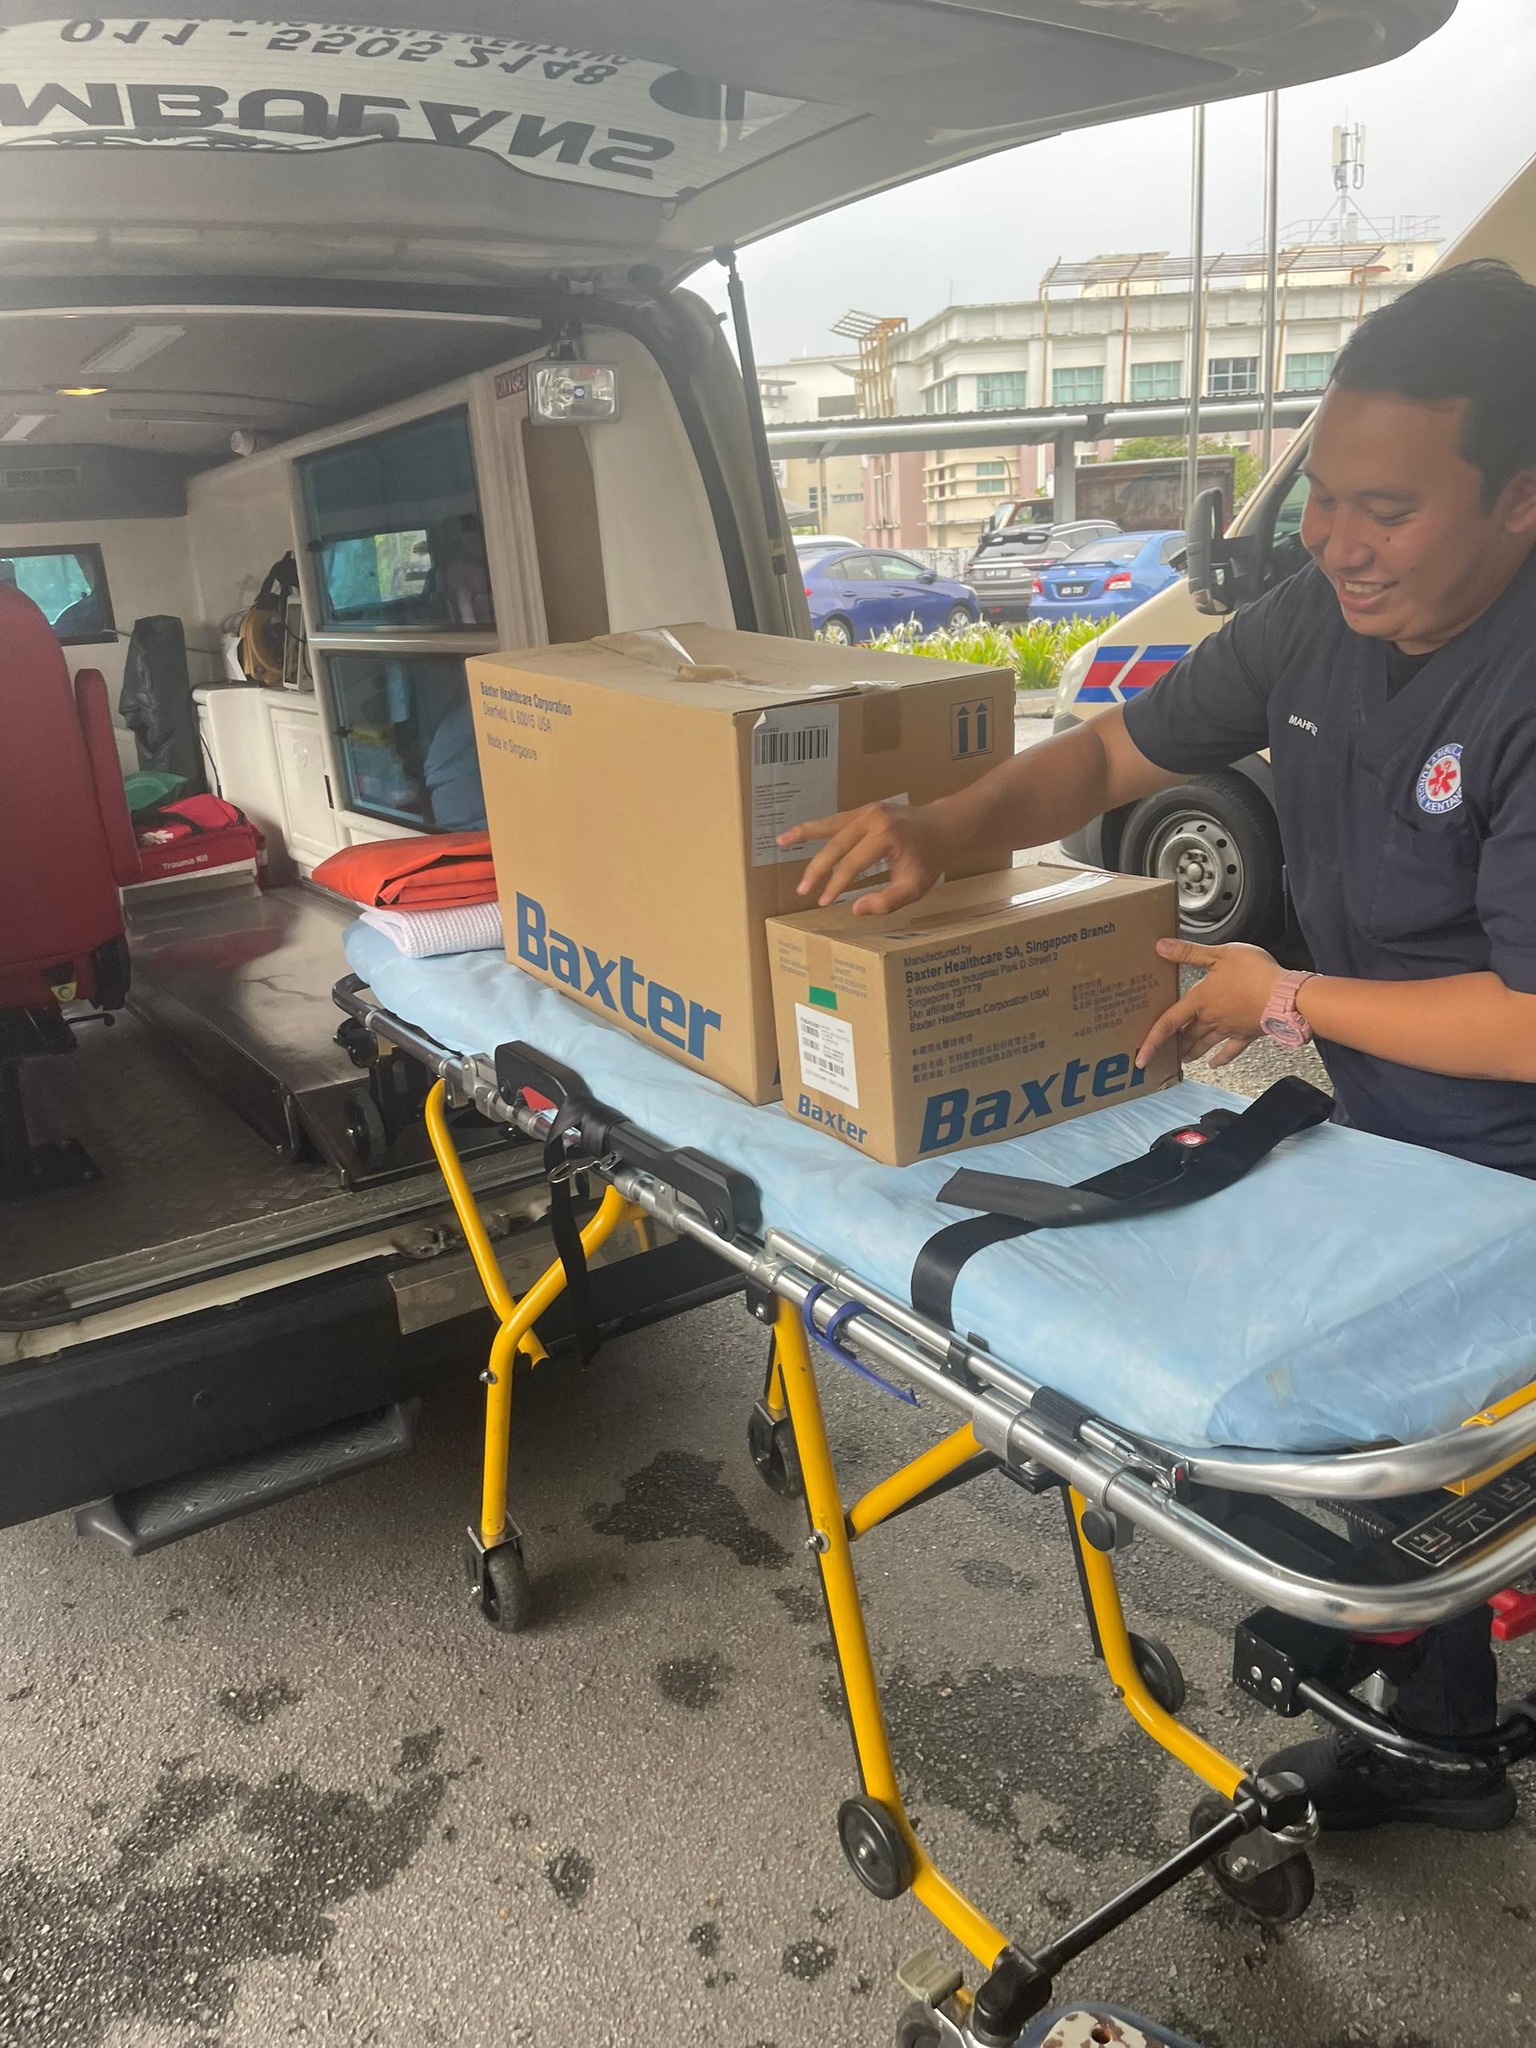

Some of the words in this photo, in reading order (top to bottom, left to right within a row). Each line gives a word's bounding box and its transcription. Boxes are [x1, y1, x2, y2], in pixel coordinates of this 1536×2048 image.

[481, 681, 498, 698] Baxter
[500, 686, 532, 707] Healthcare
[533, 693, 572, 716] Corporation
[487, 731, 502, 750] Made
[508, 739, 538, 761] Singapore
[1424, 786, 1463, 812] KENTAN
[163, 857, 194, 870] Trauma
[196, 854, 208, 863] Kit
[904, 946, 960, 968] Manufactured
[961, 944, 973, 956] by
[905, 966, 942, 984] Baxter
[944, 951, 1003, 975] Healthcare
[1005, 944, 1025, 959] SA,
[1026, 932, 1079, 954] Singapore
[1080, 921, 1116, 940] Branch
[516, 890, 722, 1061] Baxter
[907, 987, 913, 998] 2
[914, 977, 961, 996] Woodlands
[962, 965, 1000, 984] Industrial
[1001, 961, 1019, 976] Park
[1020, 960, 1027, 970] D
[1028, 953, 1052, 967] Street
[1052, 951, 1059, 961] 2
[908, 992, 950, 1010] Singapore
[910, 1019, 937, 1033] Baxter
[938, 1006, 982, 1026] Healthcare
[983, 994, 1029, 1014] Corporation
[1030, 985, 1050, 1001] USA)
[926, 1002, 955, 1018] affiliate
[956, 997, 966, 1010] of
[797, 1093, 868, 1144] Baxter
